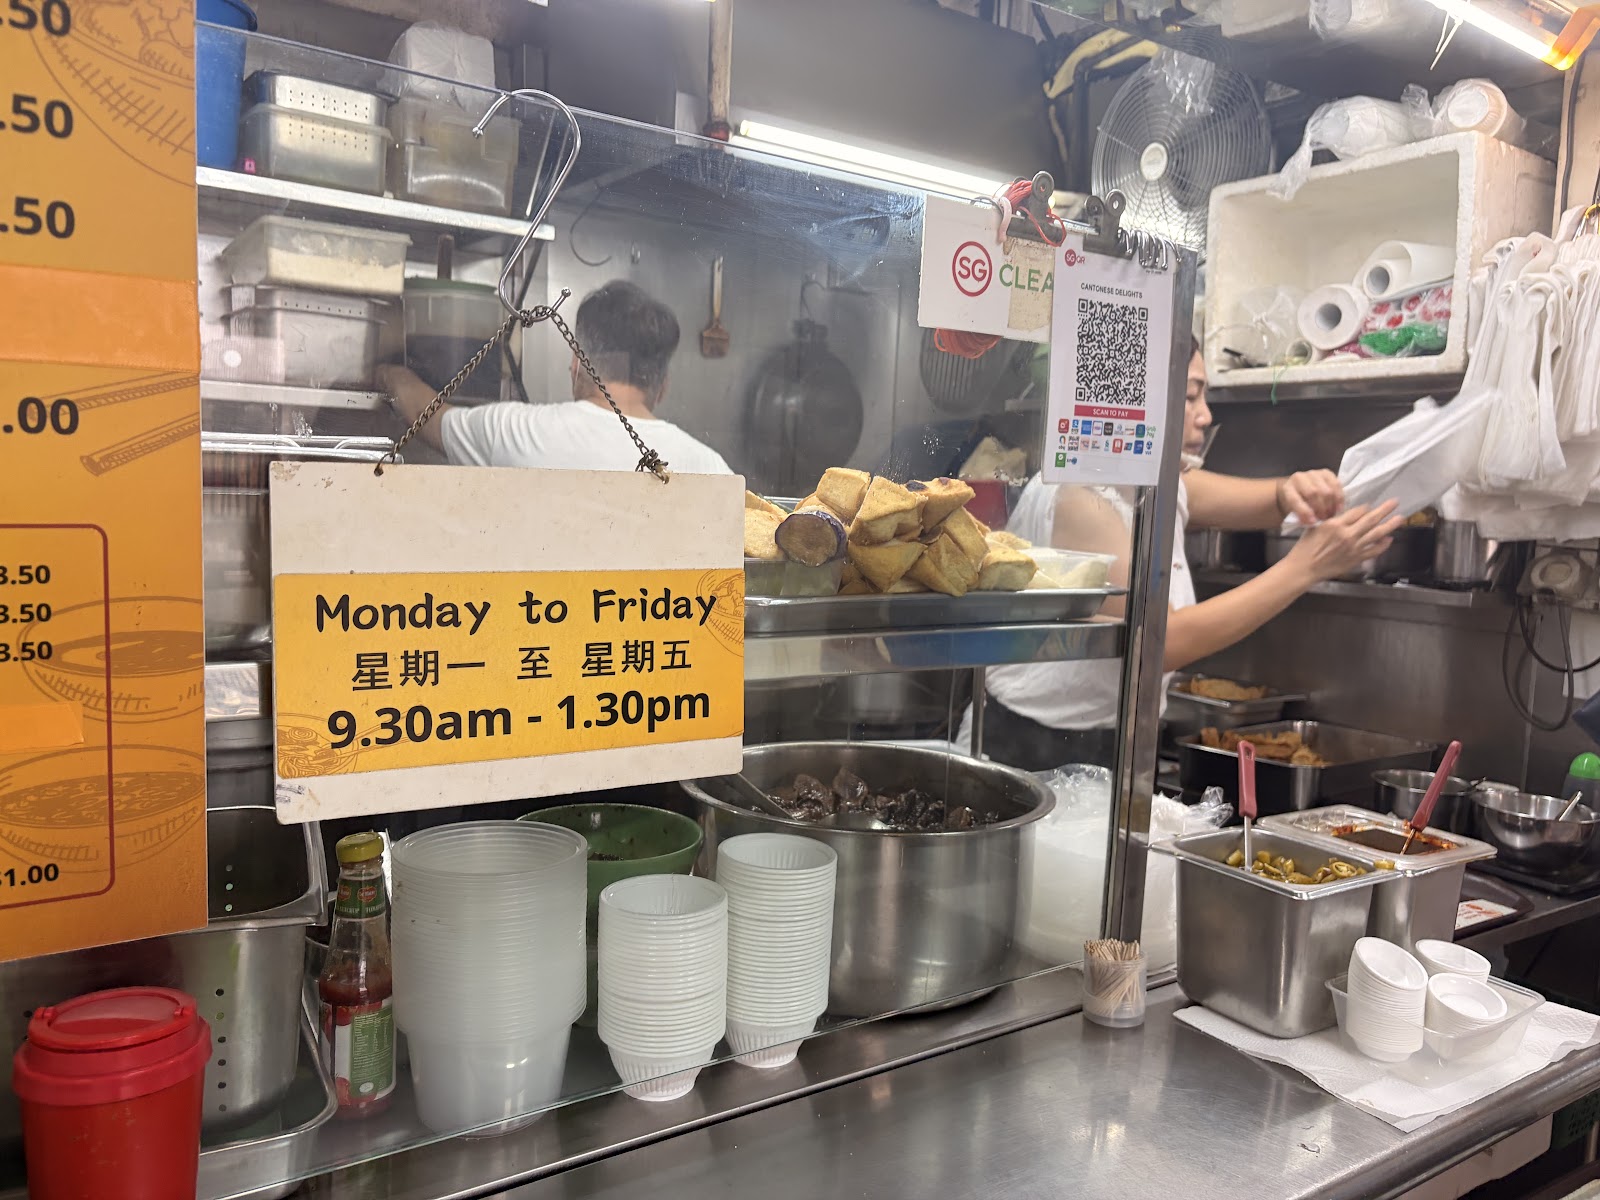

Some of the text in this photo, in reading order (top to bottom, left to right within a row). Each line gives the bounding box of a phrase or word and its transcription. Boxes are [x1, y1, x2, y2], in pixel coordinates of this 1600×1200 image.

[0, 196, 75, 239] .50
[958, 256, 987, 283] SG
[1080, 282, 1143, 299] CANTONESE DELIGHTS
[3, 396, 79, 435] .00
[1093, 408, 1129, 418] SCAN TO PAY
[315, 587, 717, 636] Monday to Friday
[351, 639, 692, 692] 星期一 至 星期五
[327, 690, 710, 750] 9.30am - 1.30pm
[0, 863, 60, 887] 1.00
